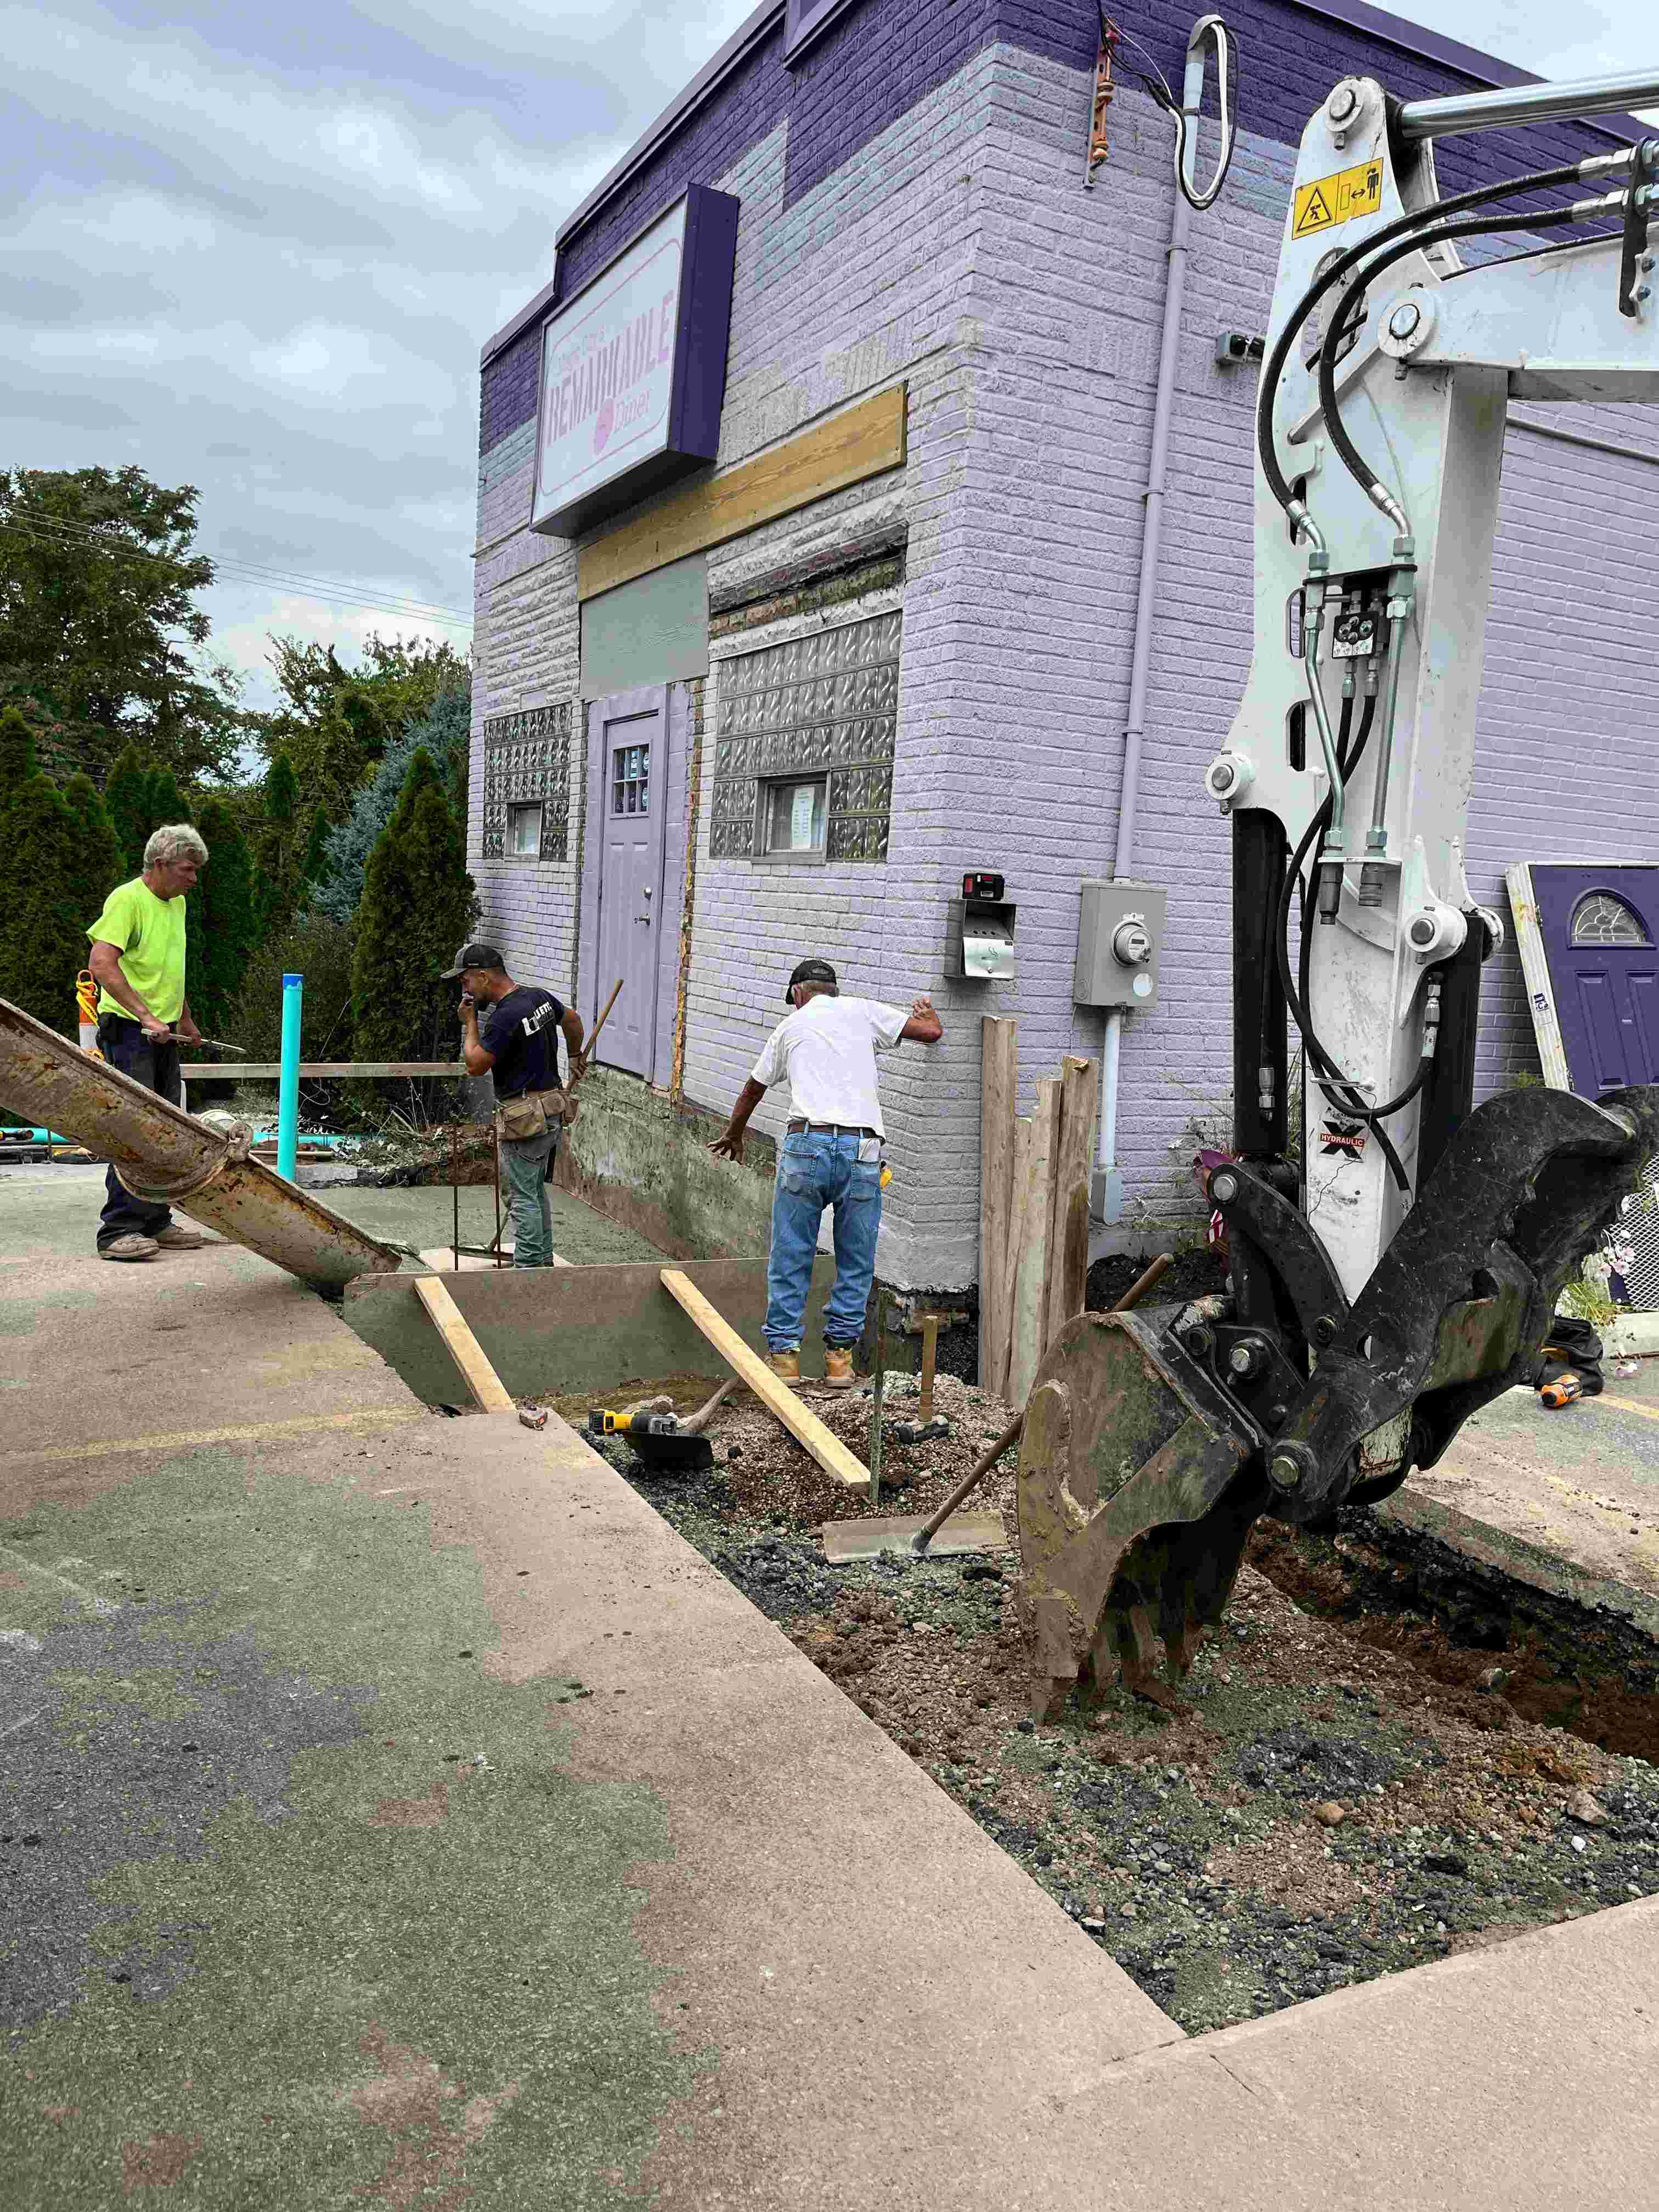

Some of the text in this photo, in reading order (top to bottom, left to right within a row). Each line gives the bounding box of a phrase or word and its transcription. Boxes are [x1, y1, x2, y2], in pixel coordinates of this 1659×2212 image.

[548, 290, 674, 447] REMARKABLE
[614, 388, 652, 435] Diner
[1321, 1134, 1364, 1147] HYDRAULIC
